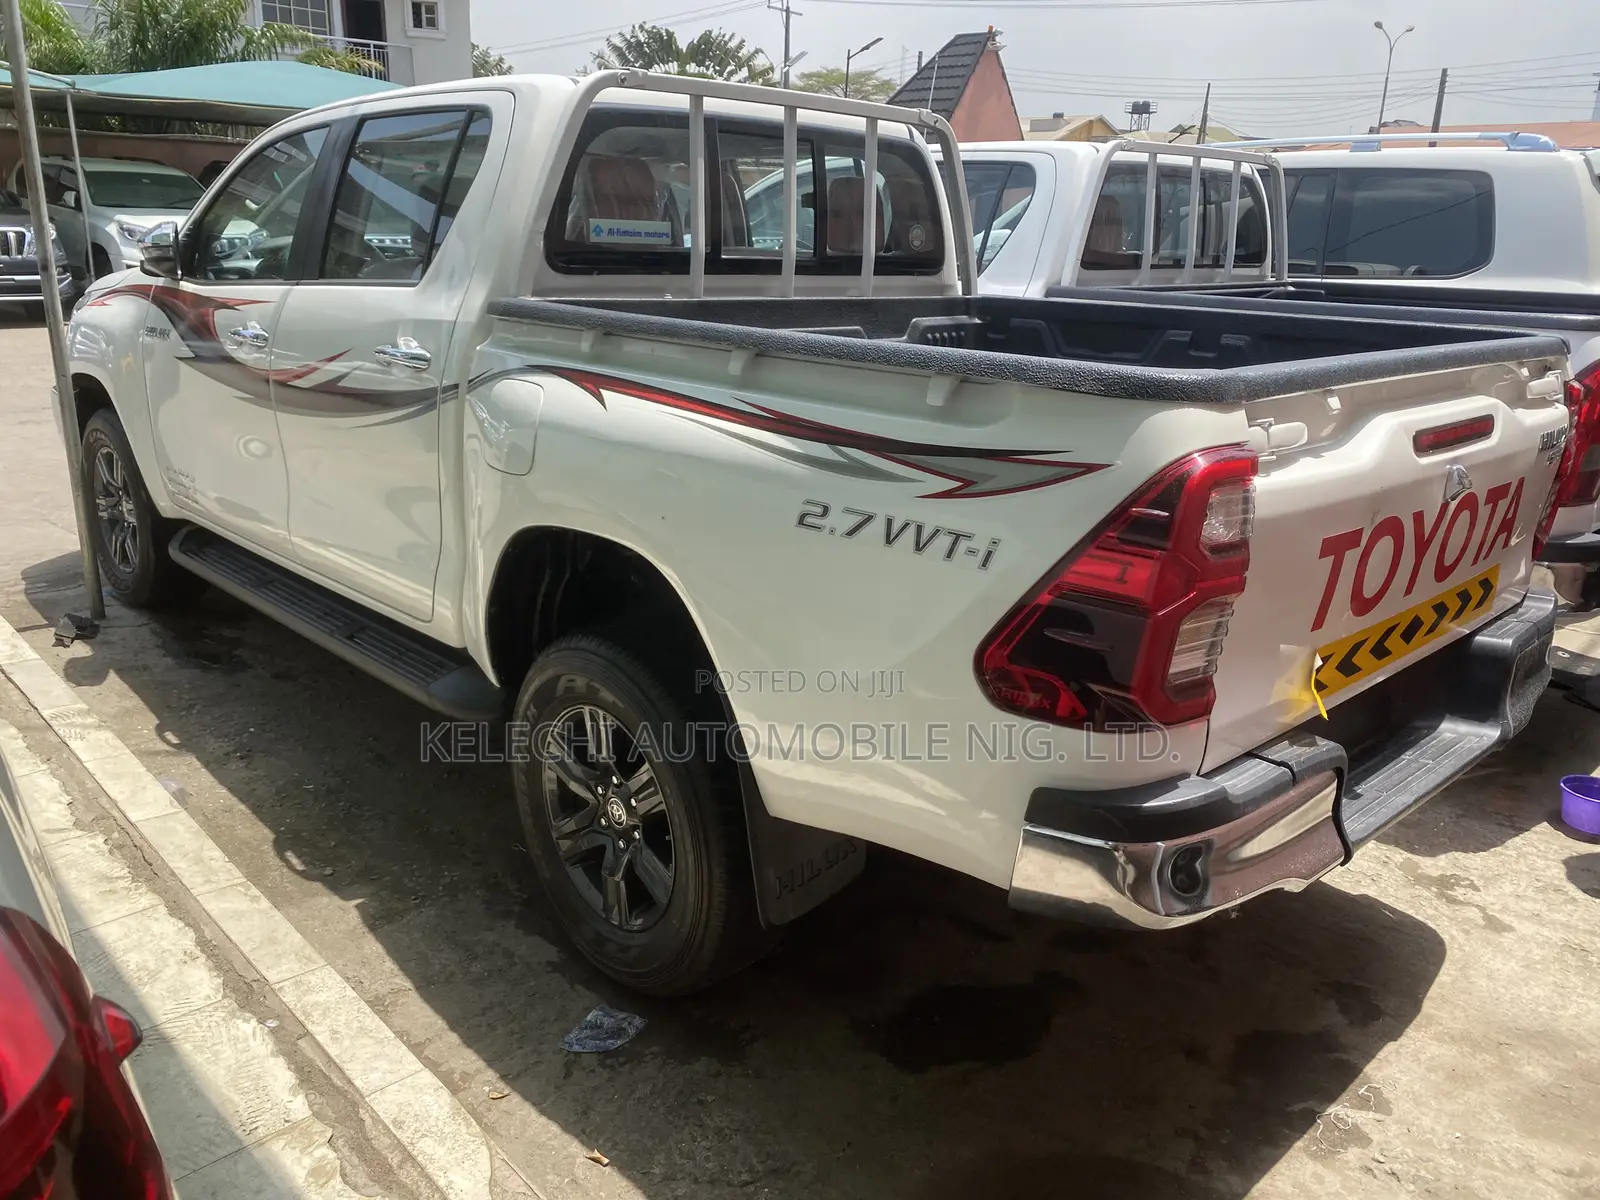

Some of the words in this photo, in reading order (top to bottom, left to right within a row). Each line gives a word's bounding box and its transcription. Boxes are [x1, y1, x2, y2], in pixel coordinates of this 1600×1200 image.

[644, 231, 670, 239] motors
[796, 499, 876, 539] 2.7
[884, 515, 1001, 571] VVT-i
[1310, 476, 1525, 632] TOYOTA
